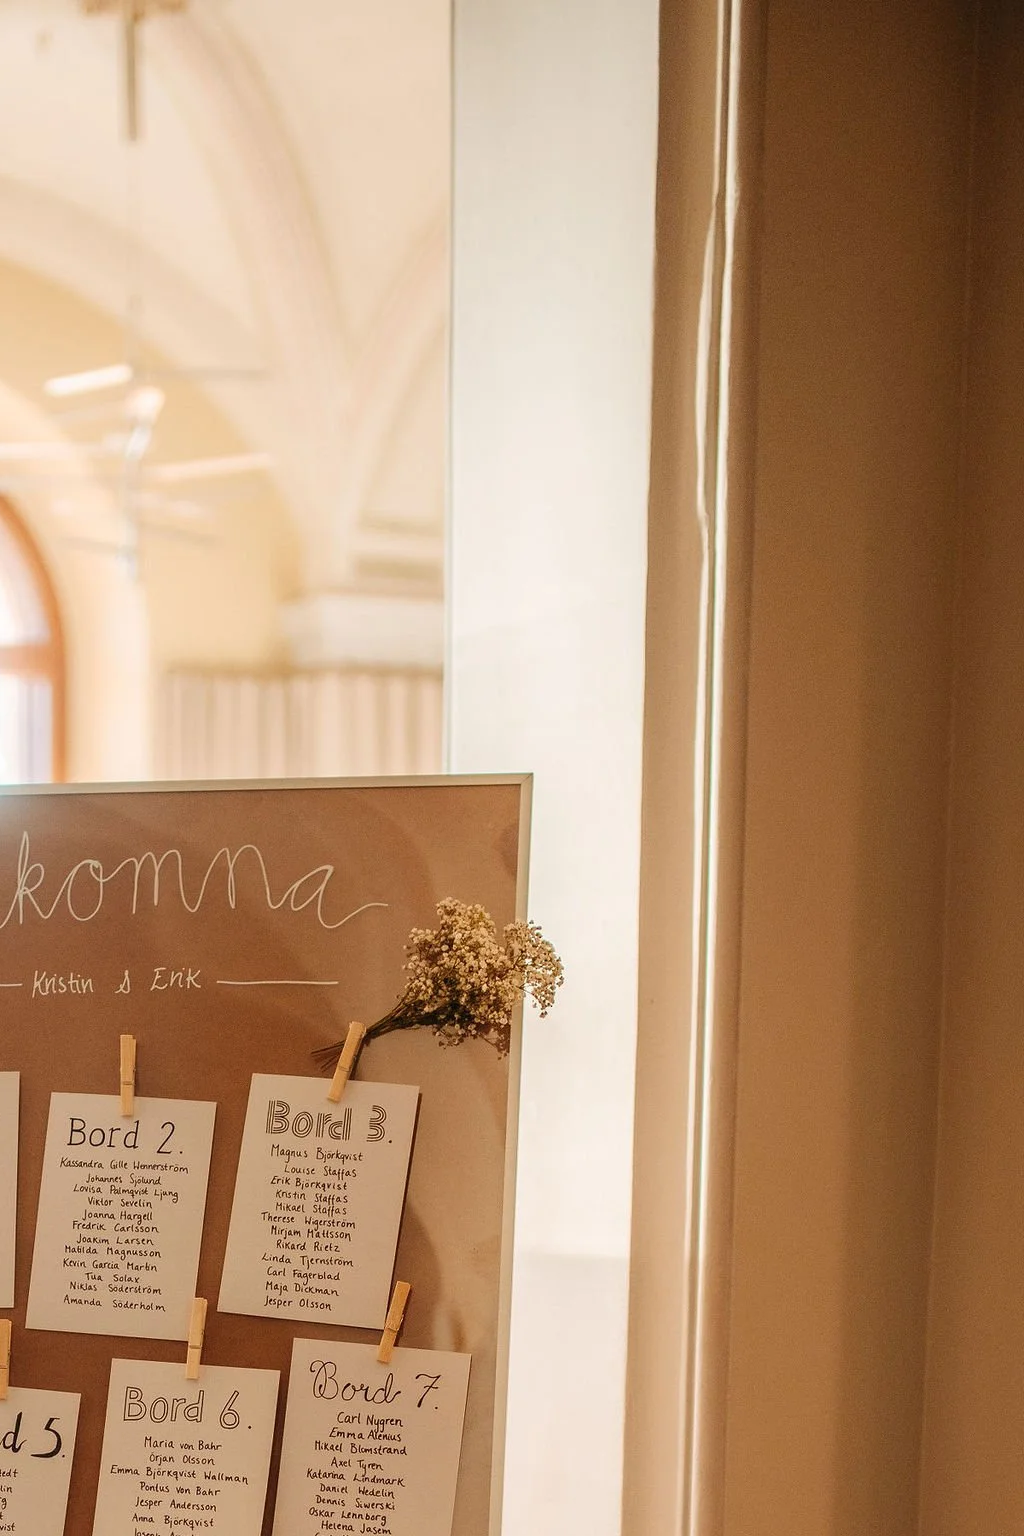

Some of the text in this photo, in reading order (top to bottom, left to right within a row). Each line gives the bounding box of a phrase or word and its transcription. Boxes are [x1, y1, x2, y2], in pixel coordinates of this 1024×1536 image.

[31, 969, 94, 998] Kristin
[150, 967, 202, 991] Erik
[265, 1098, 392, 1144] Bord 3.
[66, 1117, 183, 1154] Bord 2.
[271, 1144, 308, 1164] Magnus
[86, 1173, 123, 1184] Johannes
[270, 1175, 291, 1185] Erik
[284, 1164, 357, 1181] Louise Staffas
[87, 1196, 153, 1209] Viktor Sevelin
[82, 1209, 153, 1226] Joanna Hargell
[76, 1233, 154, 1246] Joakim Larsen
[276, 1238, 340, 1253] Rikard Rietz
[84, 1272, 104, 1282] Tua
[265, 1281, 340, 1297] Maja Dickman
[63, 1294, 102, 1307] Amanda
[263, 1295, 332, 1311] Jesper Olsson
[309, 1360, 442, 1410] Bord 7.
[123, 1386, 252, 1430] Bord 6.
[337, 1411, 404, 1433] Carl Nygren
[30, 1417, 65, 1459] 5.
[144, 1436, 222, 1451] Maria von Bahr
[110, 1464, 140, 1476] Emma
[204, 1470, 249, 1485] Wallman
[330, 1456, 384, 1478] Axel Tyren
[319, 1483, 395, 1500] Daniel Wedelin
[135, 1496, 217, 1512] Jesper Andersson
[321, 1520, 355, 1532] Helena
